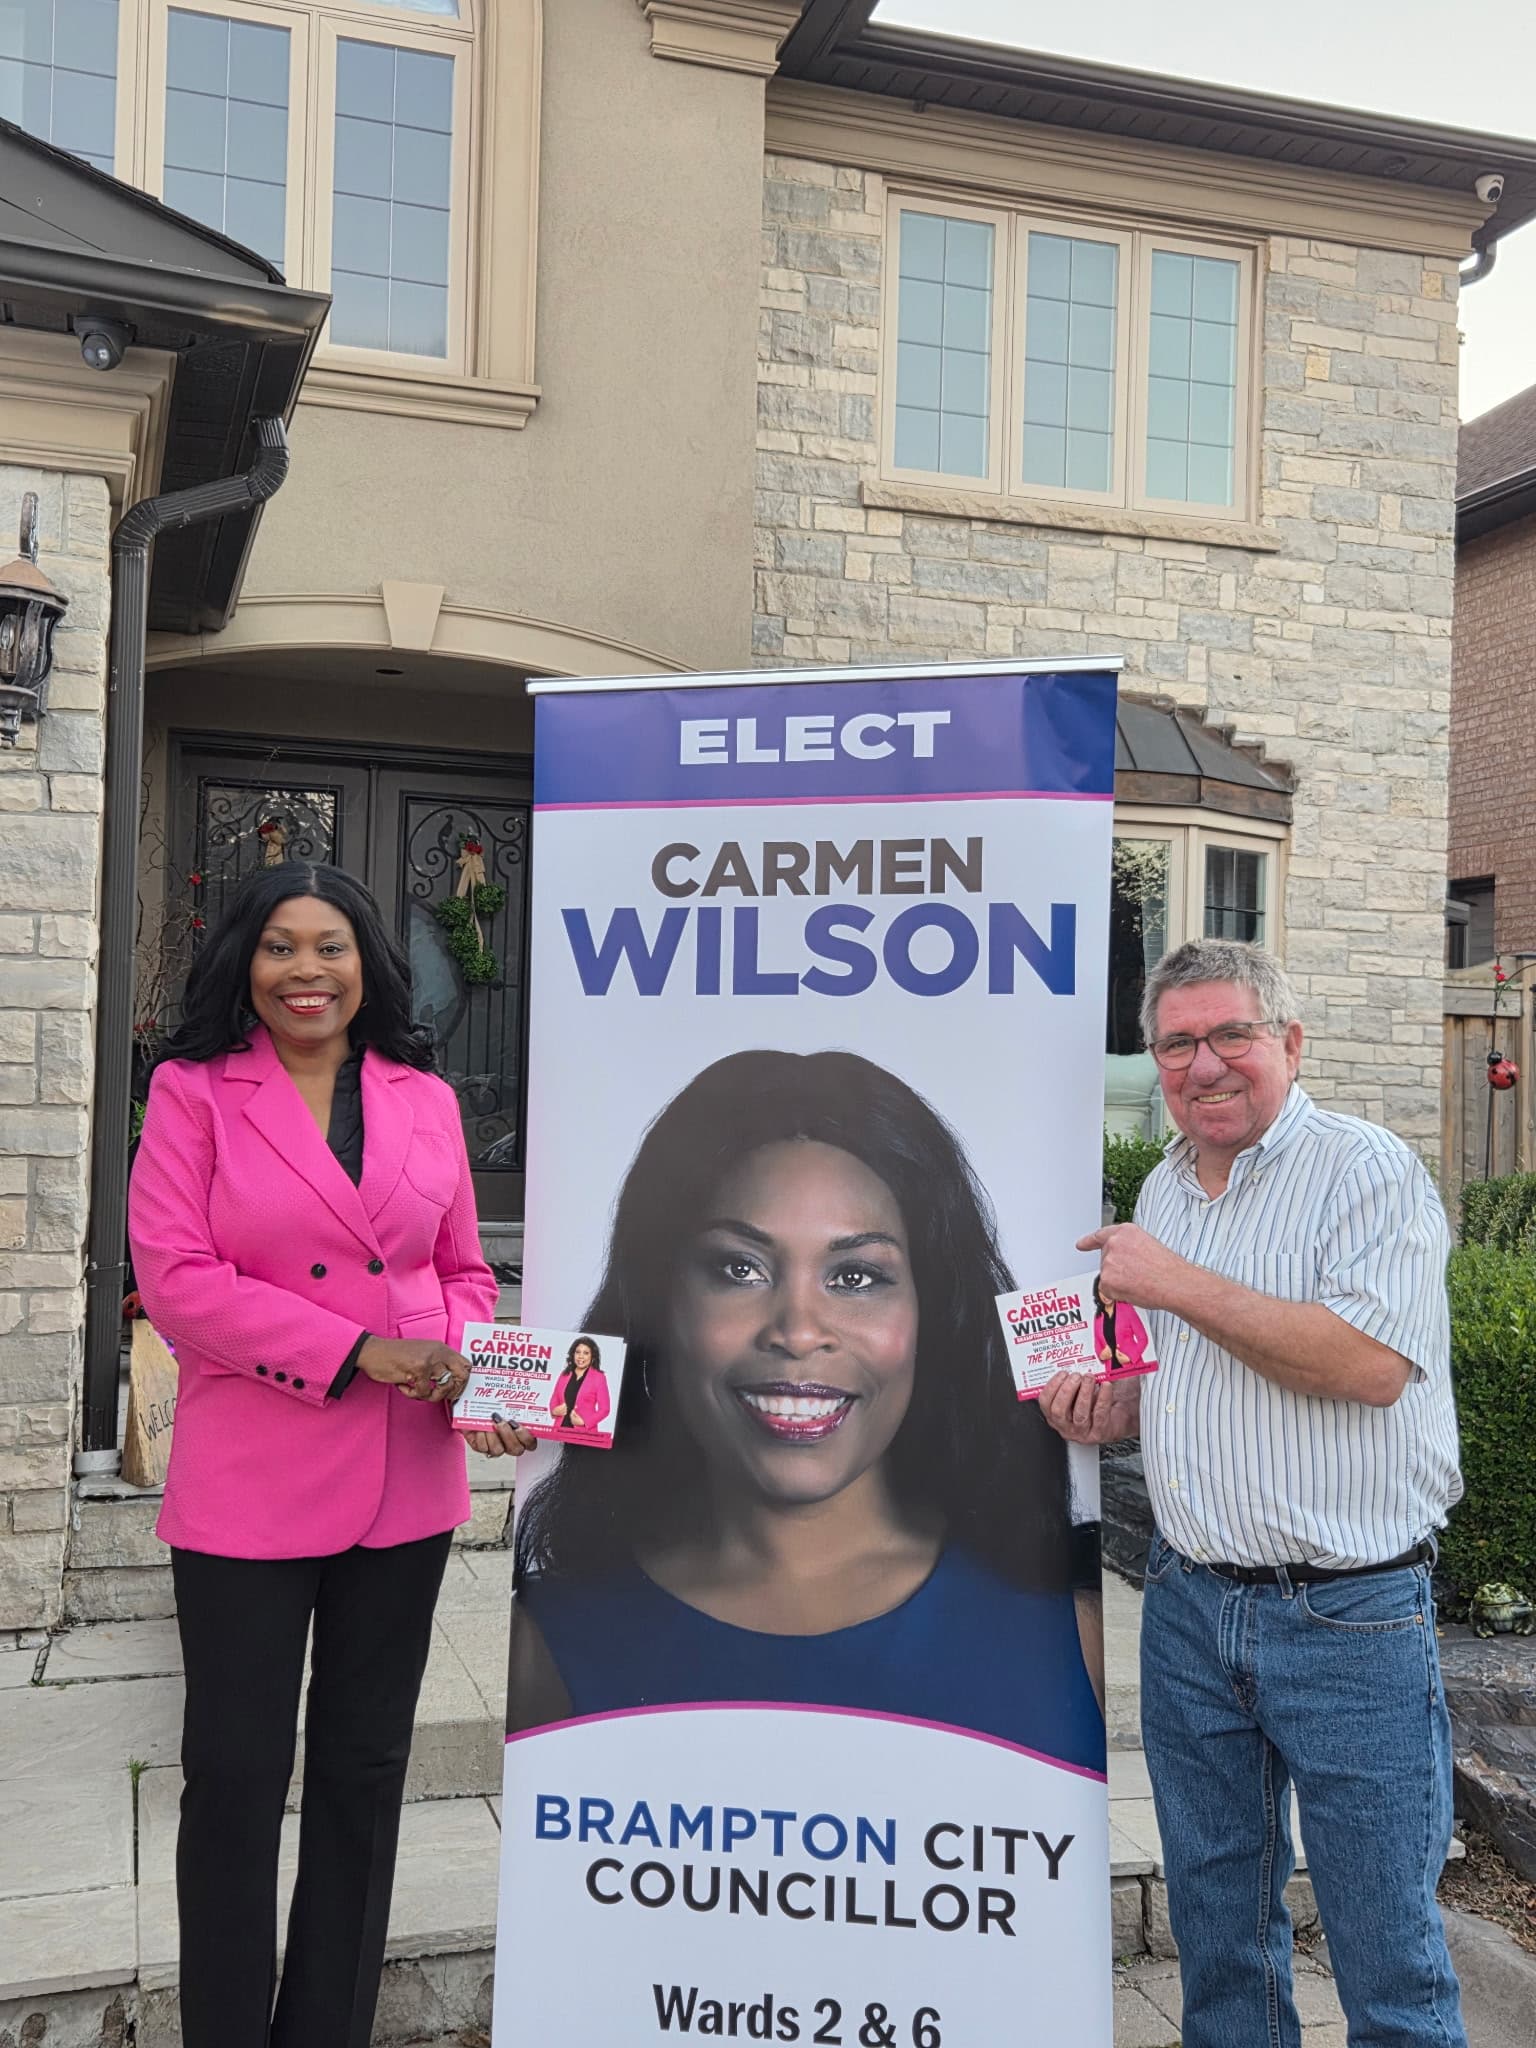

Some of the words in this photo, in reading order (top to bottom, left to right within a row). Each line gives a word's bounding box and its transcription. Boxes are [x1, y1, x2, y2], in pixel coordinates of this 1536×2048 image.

[679, 710, 951, 765] ELECT
[651, 836, 984, 898] CARMEN
[561, 901, 1077, 998] WILSON
[1022, 1287, 1058, 1305] ELECT
[1006, 1294, 1081, 1323] CARMEN
[1011, 1309, 1083, 1337] WILSON
[492, 1330, 533, 1343] ELECT
[1050, 1335, 1057, 1343] 2
[470, 1339, 552, 1359] CARMEN
[1027, 1352, 1044, 1365] THE
[1045, 1344, 1084, 1361] PEOPLE!
[1033, 1343, 1061, 1353] WORKING
[470, 1353, 549, 1373] WILSON
[474, 1387, 494, 1397] THE
[495, 1389, 540, 1402] PEOPLE!
[484, 1382, 517, 1390] WORKING
[535, 1793, 897, 1866] BRAMPTON
[923, 1822, 1076, 1880] CITY
[585, 1857, 1017, 1937] COUNCILLOR
[653, 1983, 800, 2043] Wards
[813, 1997, 843, 2046] 2
[858, 2001, 897, 2048] &
[912, 2005, 942, 2048] 6
